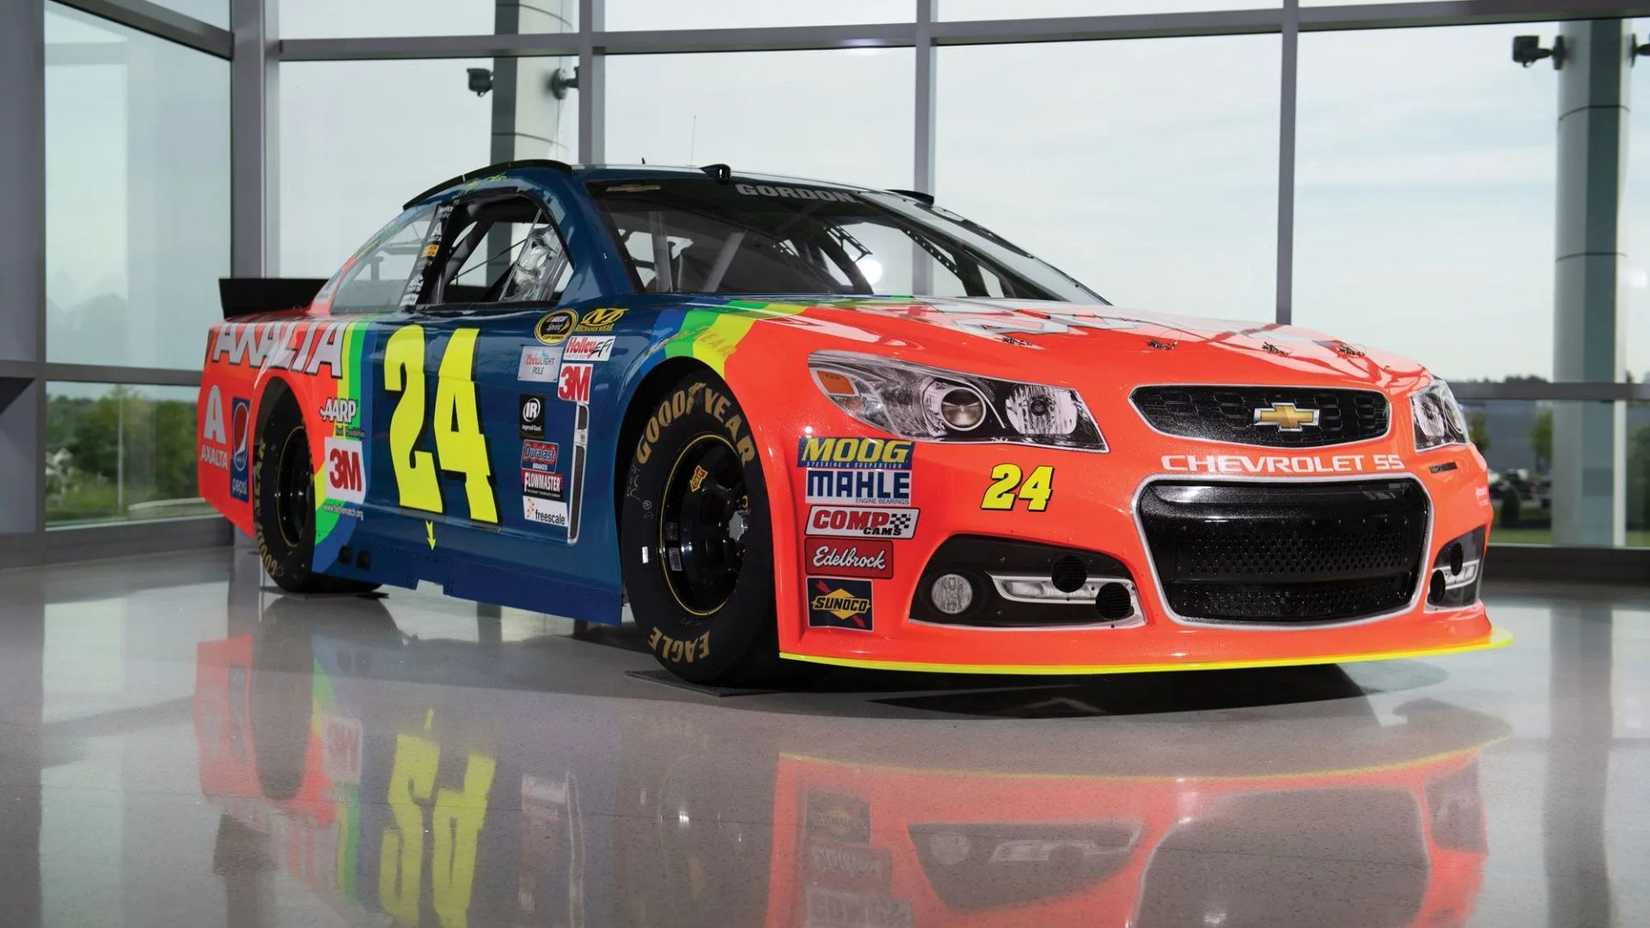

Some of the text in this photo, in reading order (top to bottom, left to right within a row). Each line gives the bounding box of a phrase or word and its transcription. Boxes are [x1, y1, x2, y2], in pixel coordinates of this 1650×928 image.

[736, 184, 860, 203] GORDON
[566, 336, 597, 358] Holley
[559, 366, 592, 403] 3M
[320, 398, 357, 424] AARP
[525, 401, 538, 419] IR
[384, 323, 499, 524] 24
[636, 382, 756, 466] GOODYEAR
[801, 437, 914, 463] MOOG
[330, 447, 362, 492] 3M
[1161, 454, 1406, 473] CHEVROLET SS
[524, 471, 561, 492] FLOWMASTER
[807, 470, 910, 499] MAHLE
[980, 462, 1056, 512] 24
[535, 508, 566, 526] freescale
[813, 509, 890, 531] COMP
[863, 526, 902, 537] CAMS
[813, 545, 886, 570] Edelbrock
[814, 596, 868, 613] SUNOCO
[648, 627, 711, 664] EAGLE
